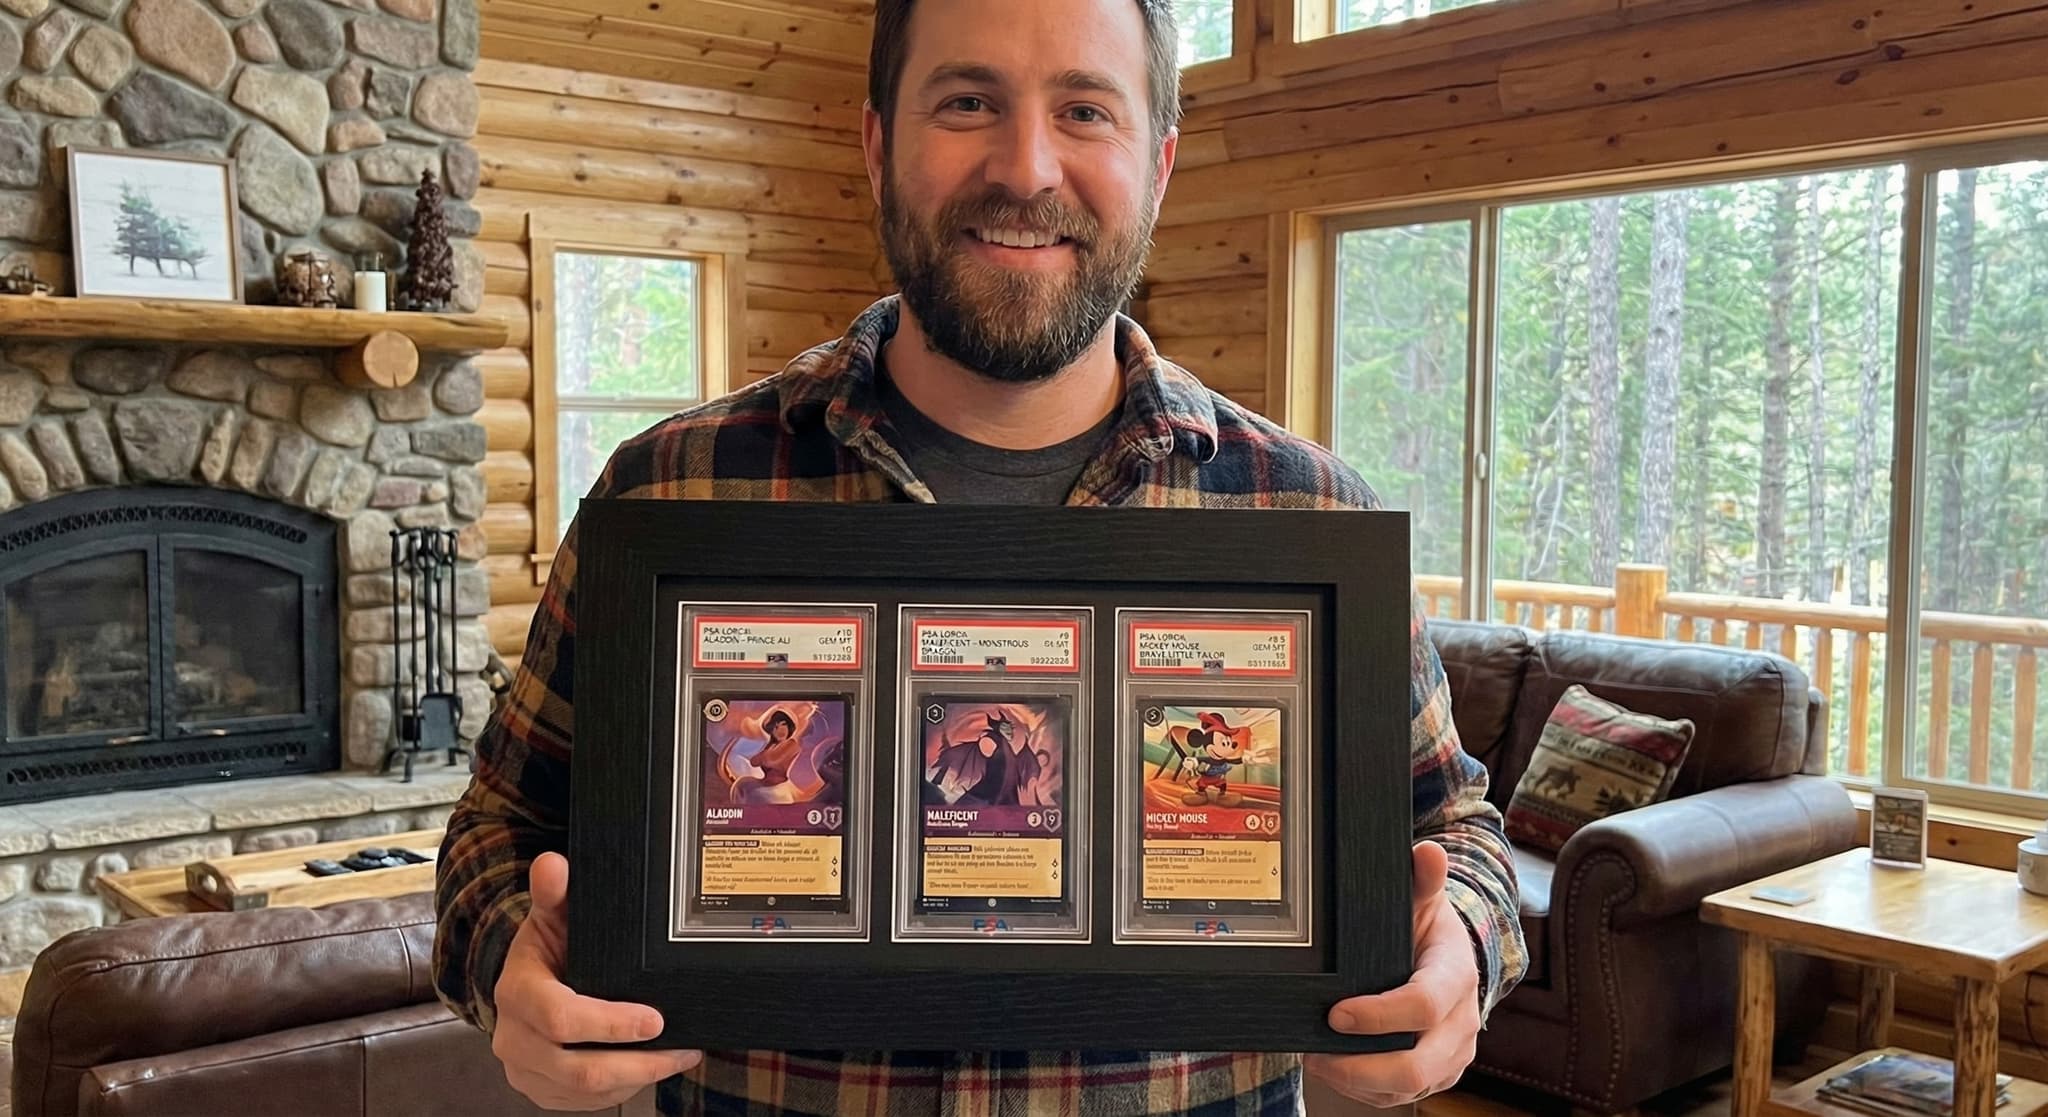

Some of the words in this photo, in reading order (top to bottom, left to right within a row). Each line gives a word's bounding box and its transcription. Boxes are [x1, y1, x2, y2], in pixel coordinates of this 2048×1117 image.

[979, 640, 1029, 648] MONSTROUS
[706, 808, 744, 819] ALADDIN
[927, 810, 978, 821] MALEFICENT
[1146, 814, 1177, 823] MICKEY
[1049, 814, 1056, 826] 9
